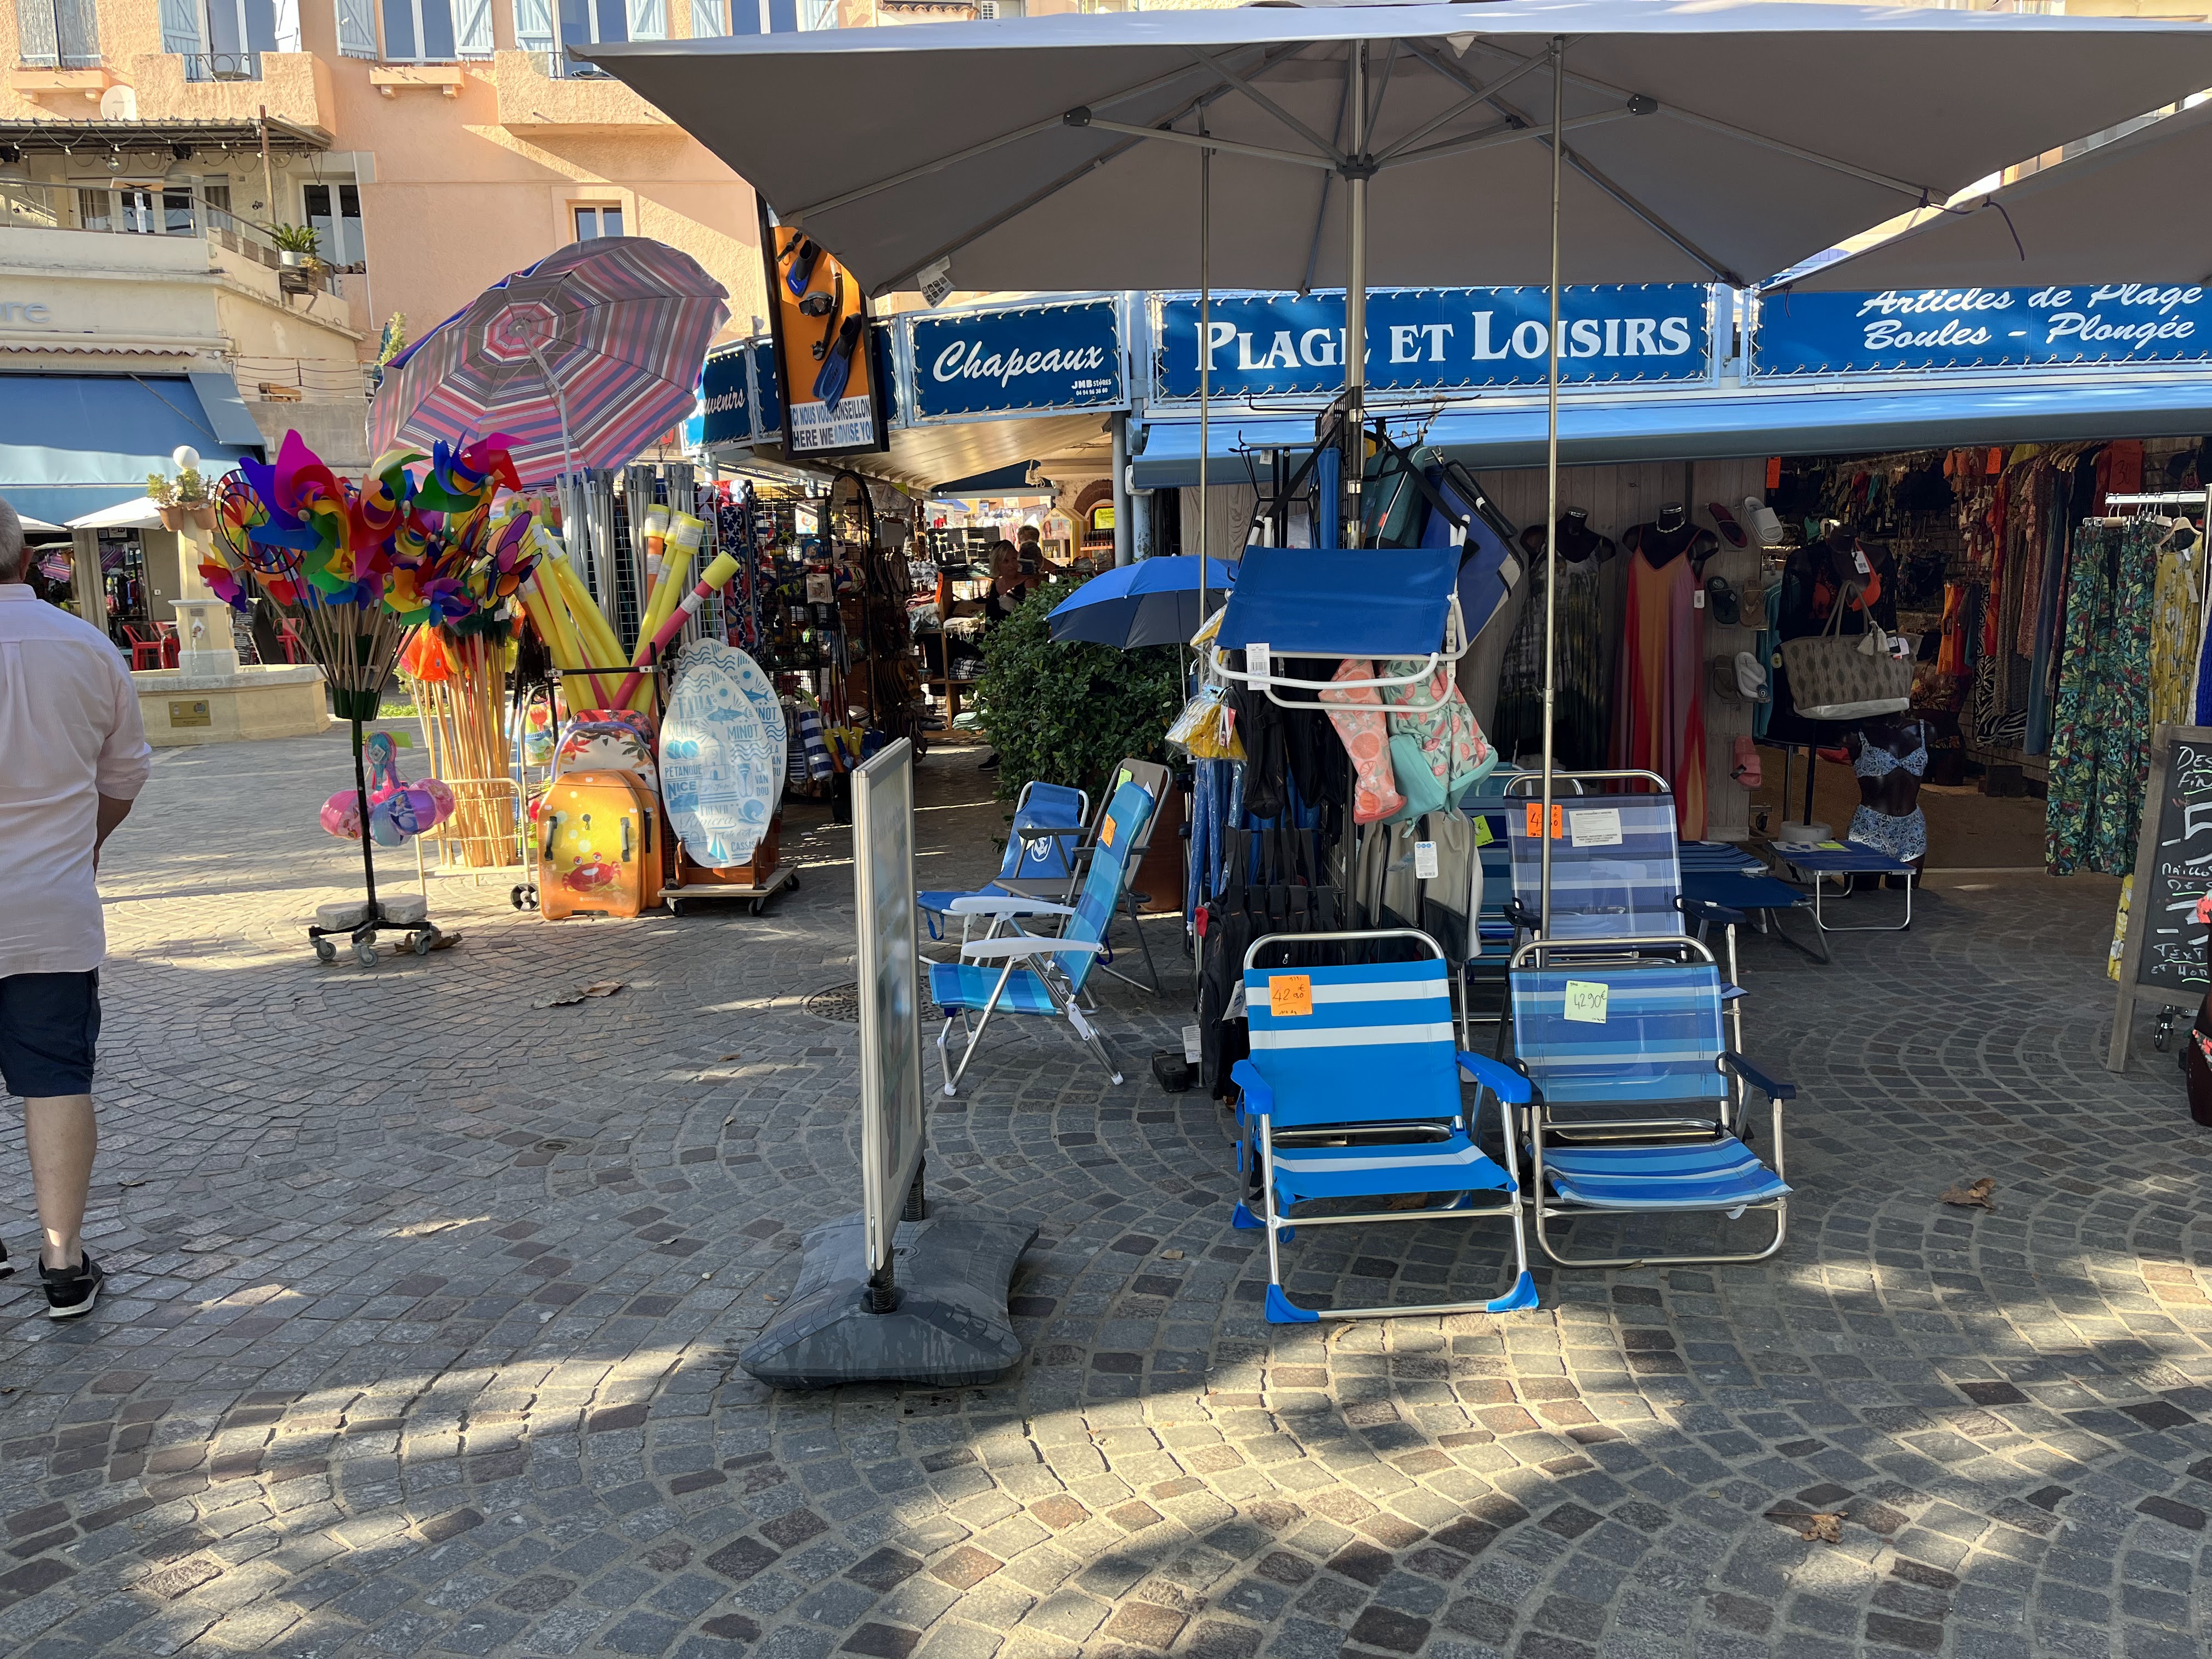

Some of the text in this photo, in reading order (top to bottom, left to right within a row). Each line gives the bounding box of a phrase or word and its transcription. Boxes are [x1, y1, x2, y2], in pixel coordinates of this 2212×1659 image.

[1856, 284, 2203, 317] Articles de Plage
[1389, 324, 1454, 363] ET
[1471, 311, 1691, 360] LOISIRS
[1864, 319, 1992, 349] Boules
[2046, 312, 2195, 349] Plongée
[933, 341, 1104, 388] Chapeaux
[1071, 380, 1093, 390] JMB
[799, 405, 816, 426] NOUS
[793, 429, 817, 448] HERE
[819, 427, 834, 445] WE
[833, 423, 859, 444] ADVISE
[727, 724, 759, 740] MINOT
[755, 775, 768, 785] VAN
[668, 782, 696, 799] NICE
[757, 786, 769, 796] DOU
[731, 840, 755, 852] CASSIS
